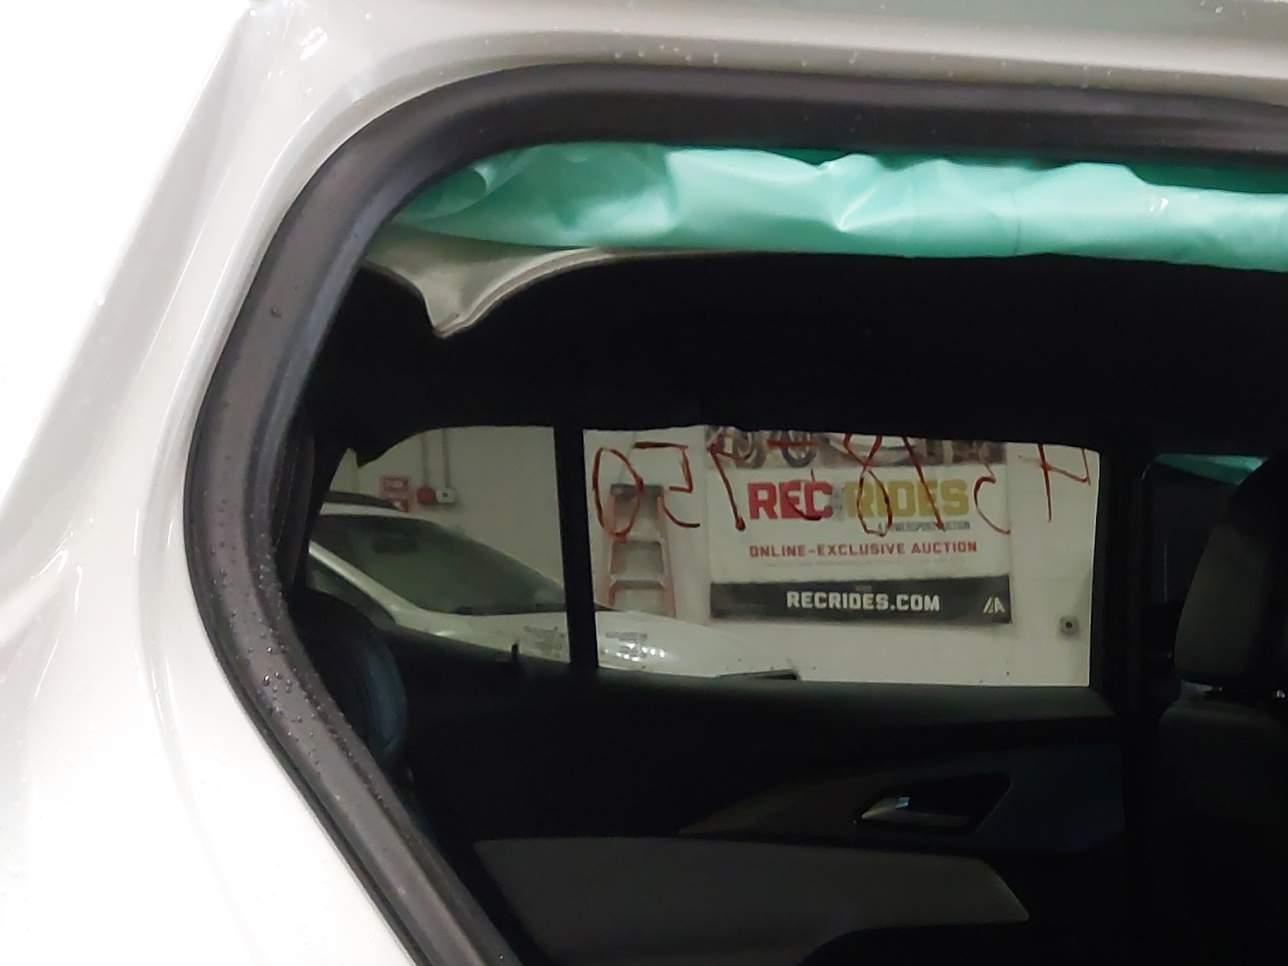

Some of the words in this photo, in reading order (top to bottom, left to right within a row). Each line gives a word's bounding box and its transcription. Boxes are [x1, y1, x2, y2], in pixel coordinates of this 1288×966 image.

[747, 481, 834, 519] REC
[845, 479, 970, 518] RIDES
[750, 542, 905, 558] ONLINE-EXCLUSIVE
[911, 541, 977, 555] AUCTION
[786, 590, 940, 612] RECRIDES.COM
